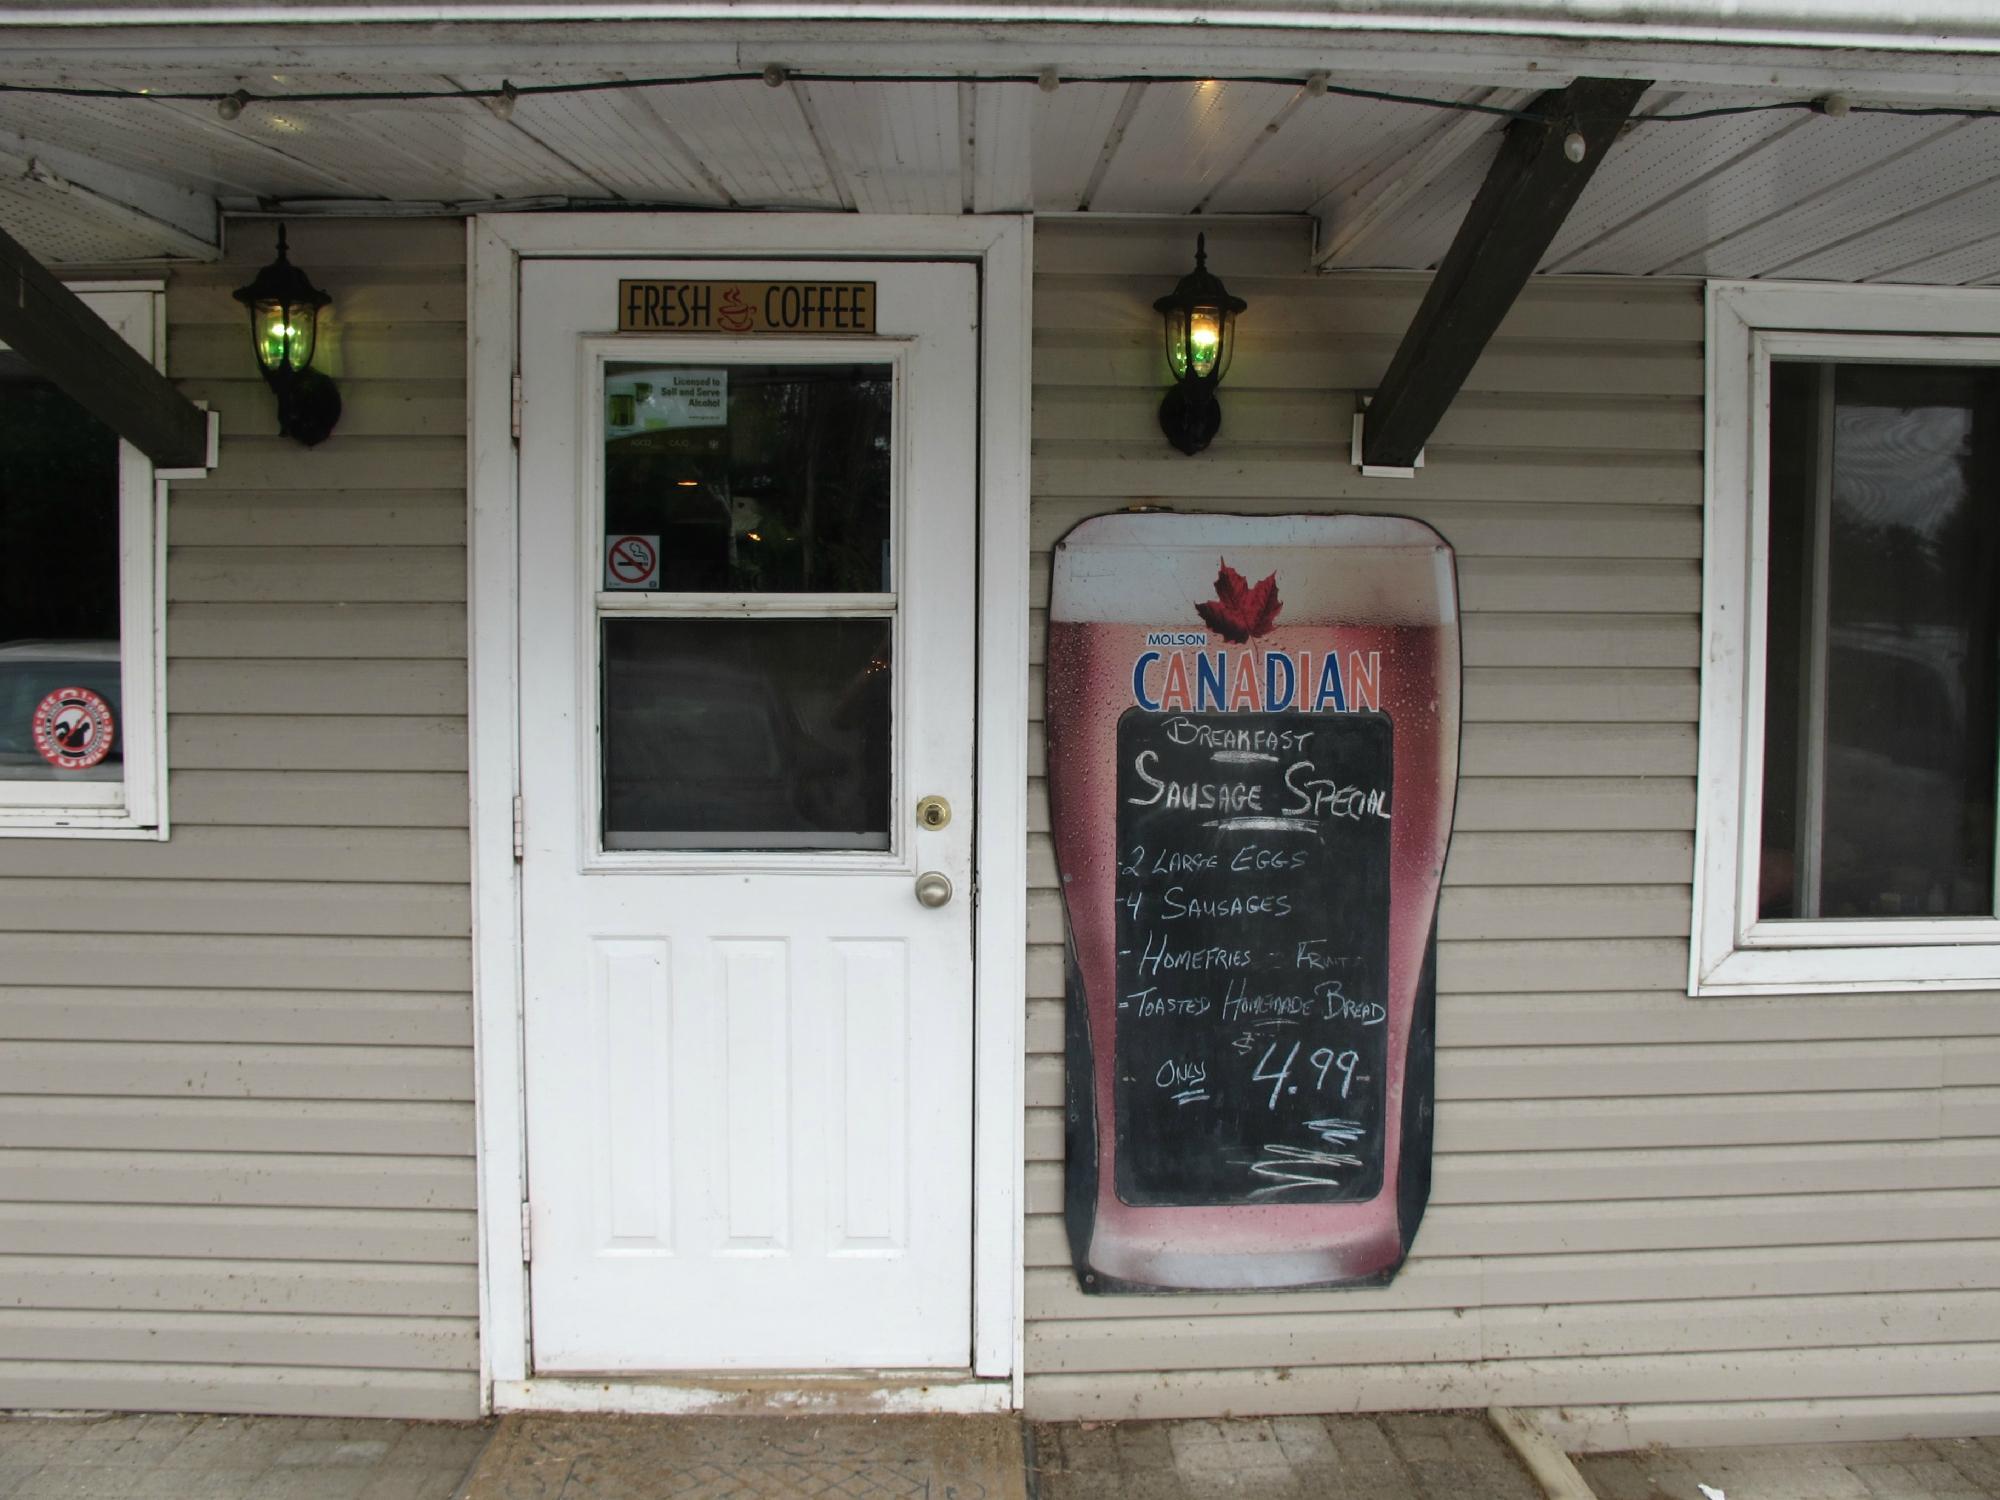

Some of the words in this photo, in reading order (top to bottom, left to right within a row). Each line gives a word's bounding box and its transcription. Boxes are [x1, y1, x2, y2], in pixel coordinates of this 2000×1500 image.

[627, 285, 711, 327] FRESH
[765, 286, 866, 328] COFFEE
[661, 387, 677, 397] Sell
[679, 387, 694, 397] and
[696, 387, 720, 397] Serve
[673, 376, 710, 386] Licensed
[712, 377, 720, 386] to
[688, 398, 720, 408] Alcohol
[1147, 633, 1207, 646] MOLSON
[1132, 650, 1380, 713] CANADIAN
[1161, 716, 1314, 751] BREAKFAST
[1128, 750, 1263, 812] SAUSAGE
[1152, 849, 1218, 873] LARGE
[1231, 845, 1309, 872] EGGS
[1162, 887, 1291, 920] SAUSAGES
[1139, 930, 1251, 976] HOMEFRIES
